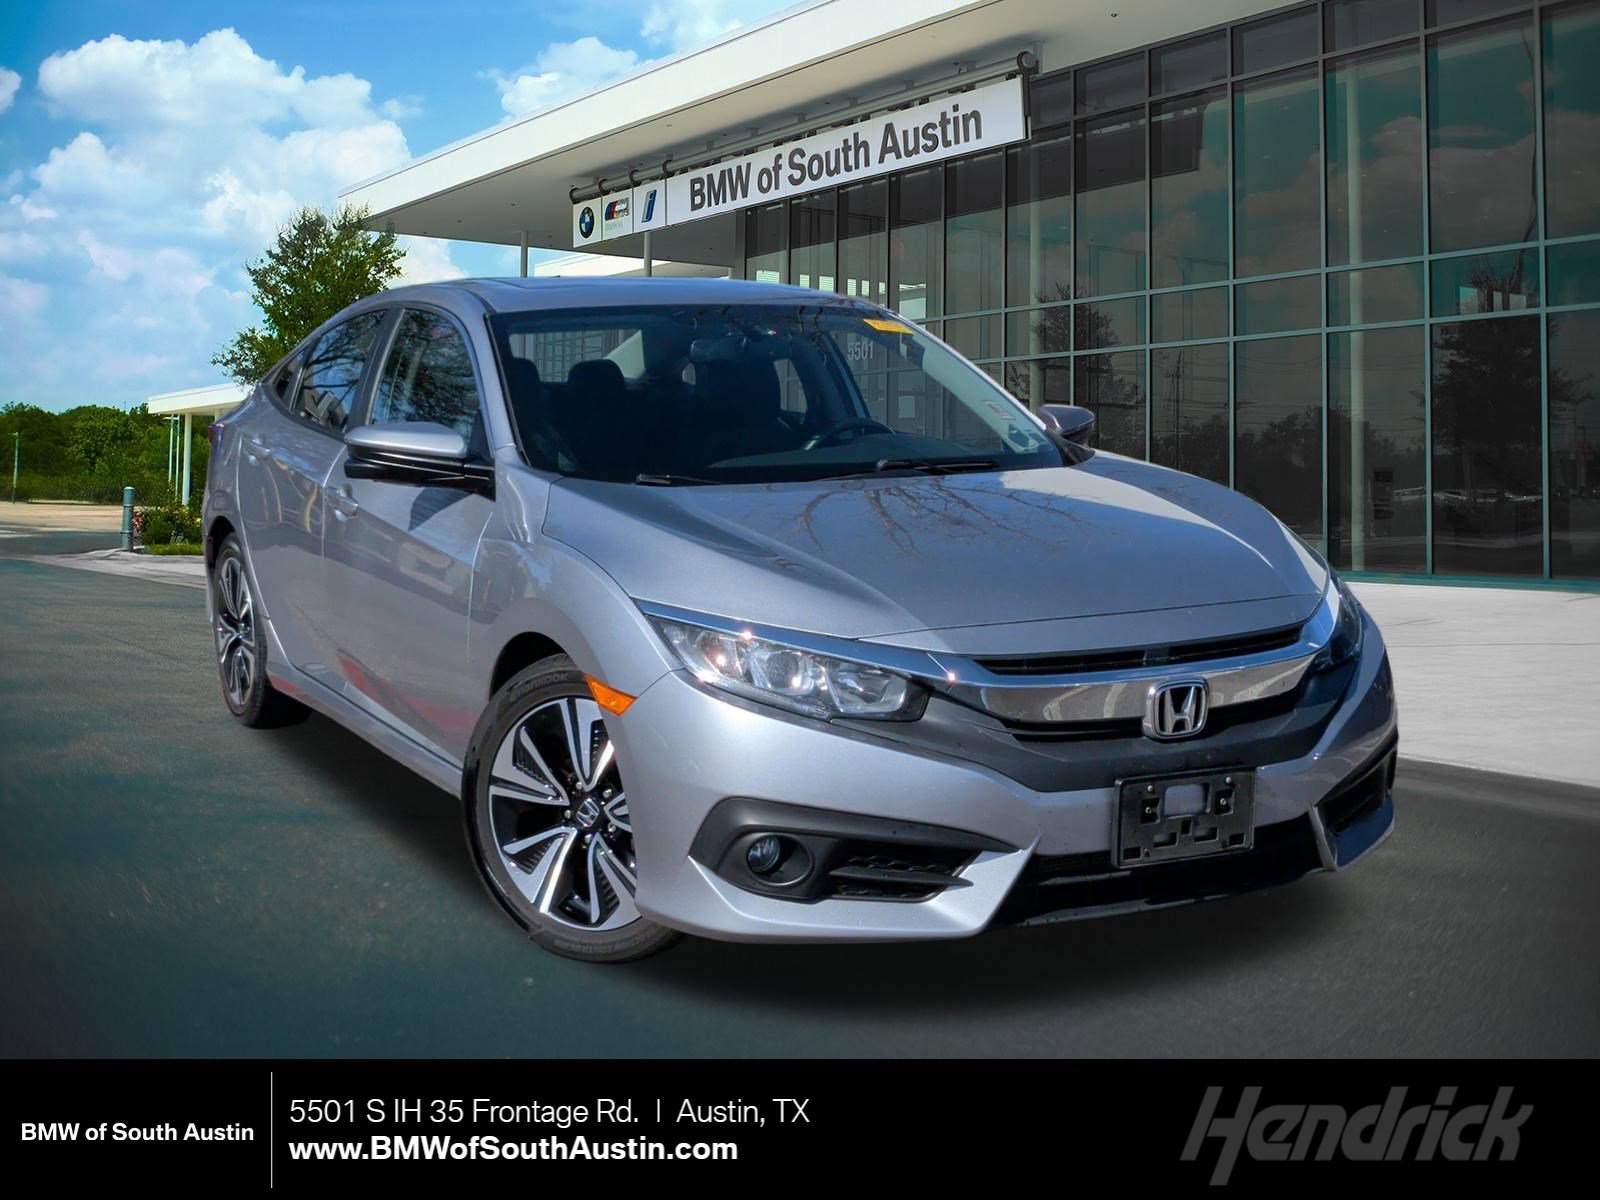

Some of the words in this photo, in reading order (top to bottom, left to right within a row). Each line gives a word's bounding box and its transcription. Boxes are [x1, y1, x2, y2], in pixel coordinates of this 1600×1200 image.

[690, 162, 751, 211] BMW
[757, 153, 783, 194] of
[787, 132, 870, 186] South
[878, 103, 982, 164] Austin
[847, 340, 874, 361] 5501
